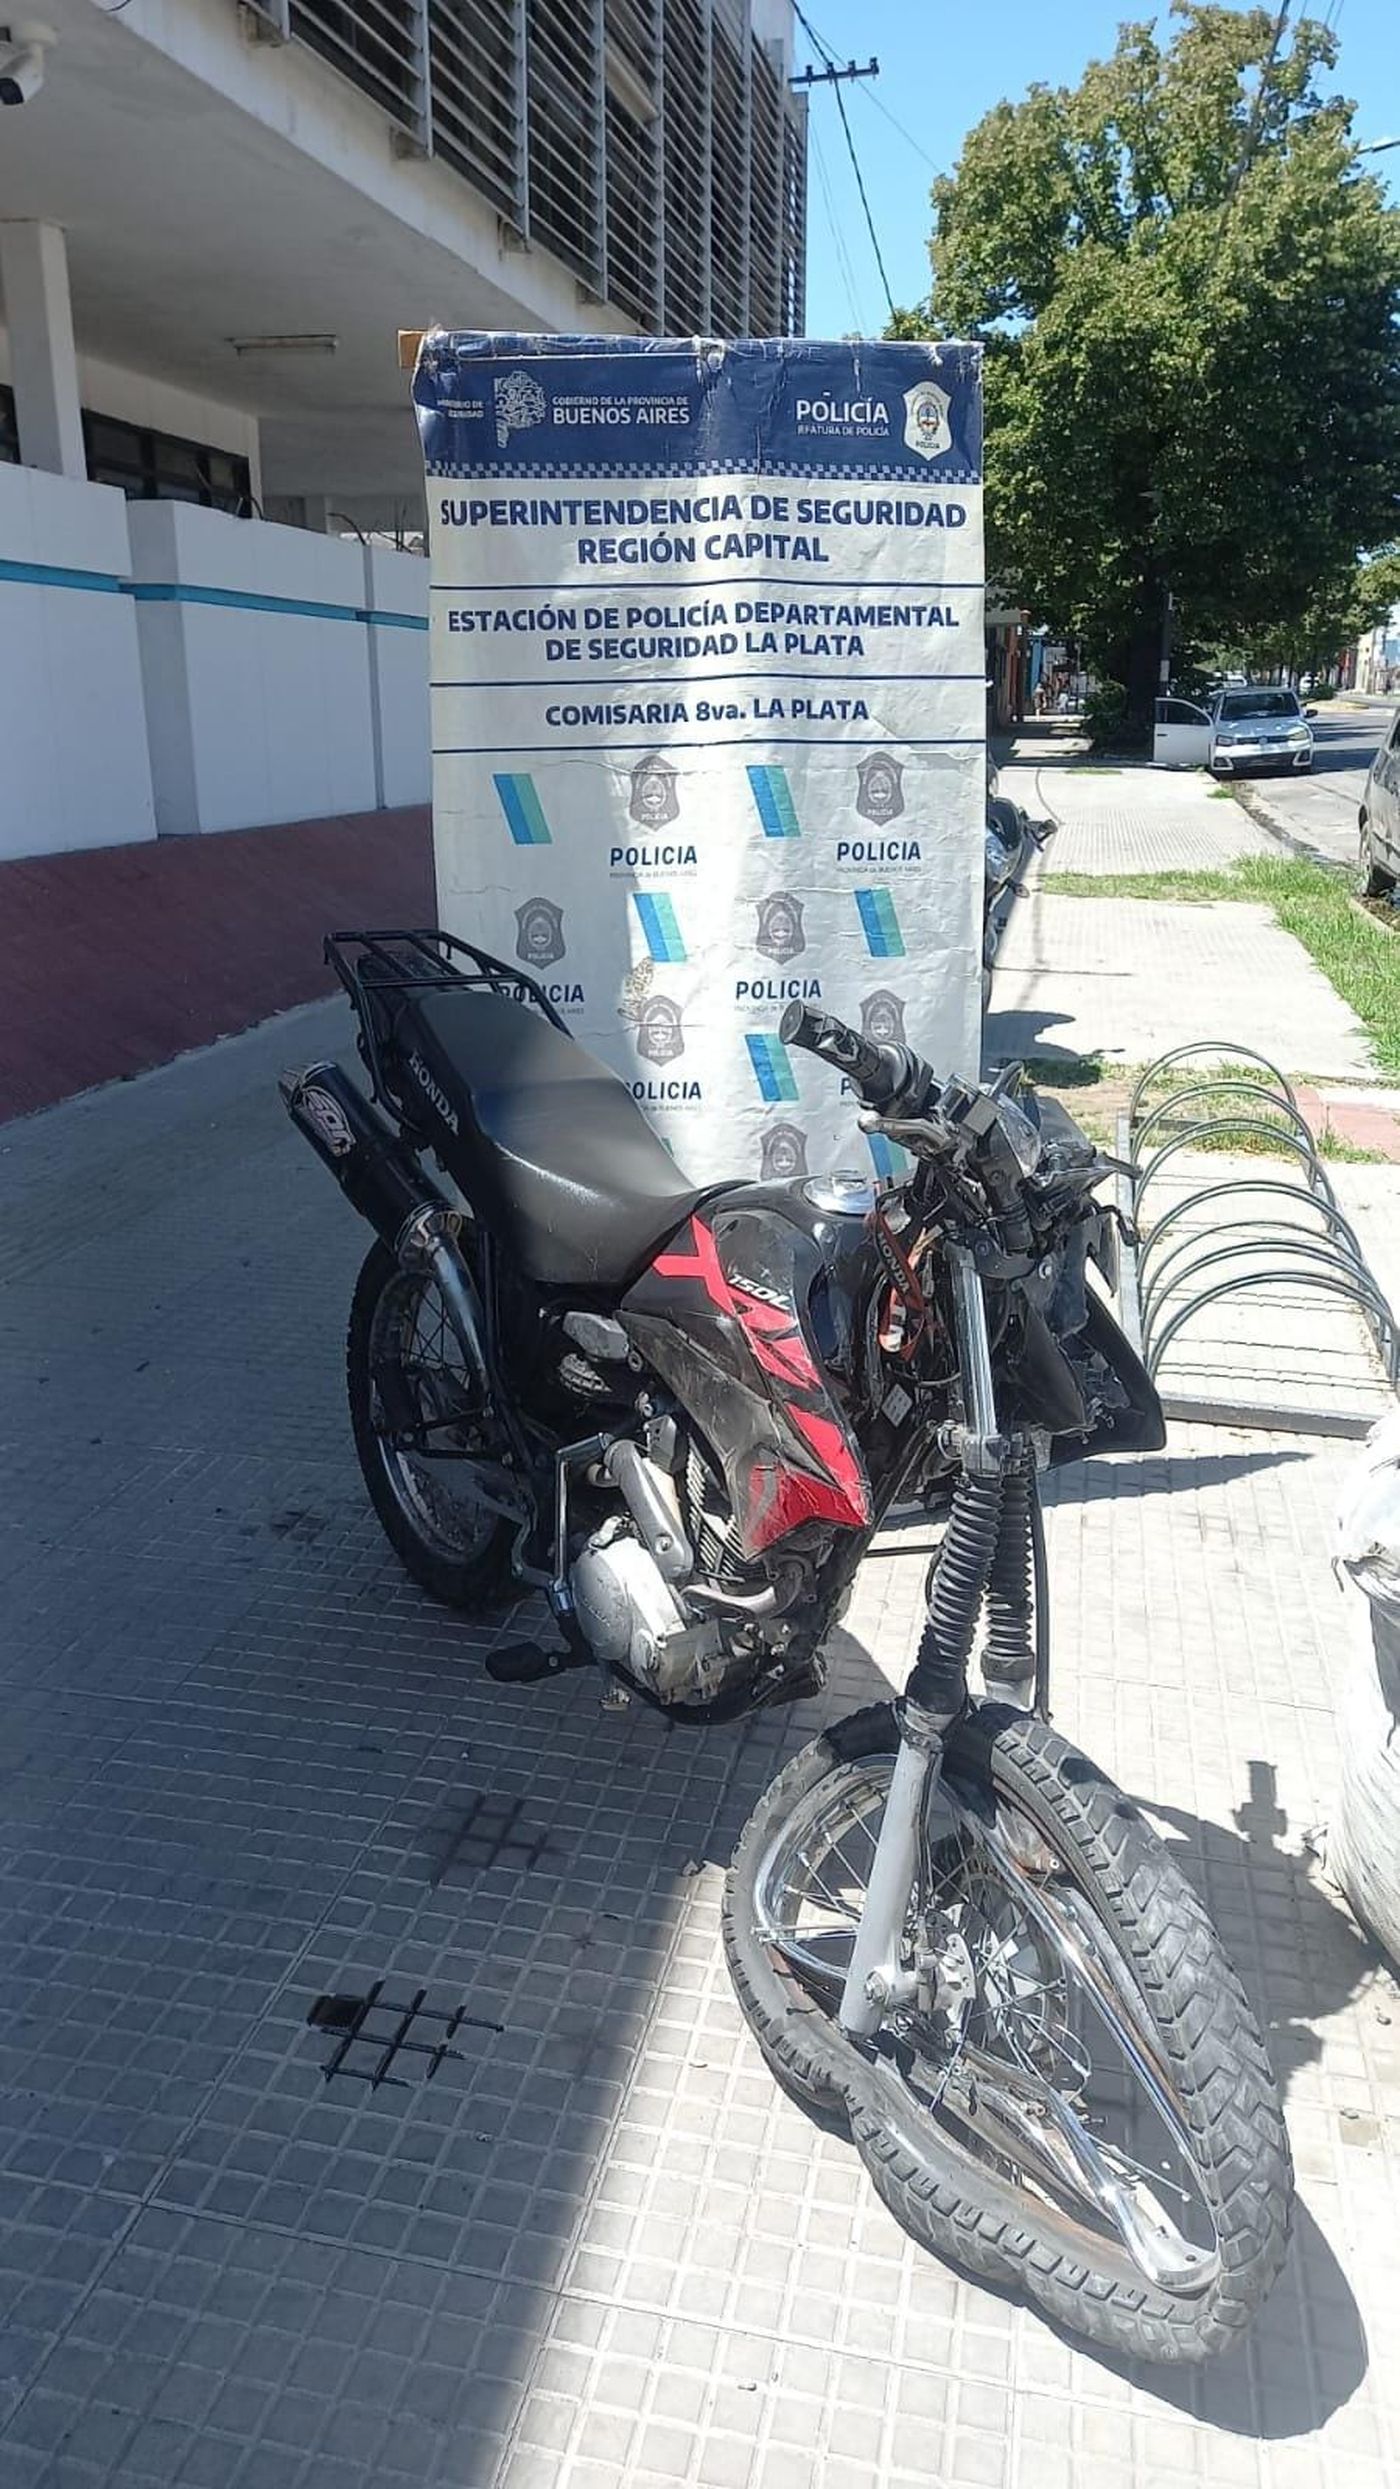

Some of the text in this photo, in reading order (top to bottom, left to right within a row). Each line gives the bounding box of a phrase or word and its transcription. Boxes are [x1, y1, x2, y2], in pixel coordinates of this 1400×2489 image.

[600, 396, 613, 406] DE
[614, 396, 626, 406] LA
[676, 396, 689, 406] DE
[796, 396, 889, 424] POLICÍA
[553, 407, 690, 424] BUENOS AIRES
[441, 495, 967, 528] SUPERINTENDENCIA DE SEGURIDAD
[578, 531, 829, 564] REGIÓN CAPITAL
[448, 600, 960, 632] ESTACIÓN DE POLICÍA DEPARTAMENTAL
[545, 632, 865, 661] DE SEGURIDAD LA PLATA
[545, 698, 870, 726] COMISARIA 8va. LA PLATA
[610, 846, 698, 866] POLICIA
[837, 841, 921, 861] POLICIA
[735, 979, 822, 1000] POLICIA
[408, 1048, 459, 1136] HONDA
[626, 1081, 702, 1100] OLICIA
[727, 1273, 791, 1311] 150L
